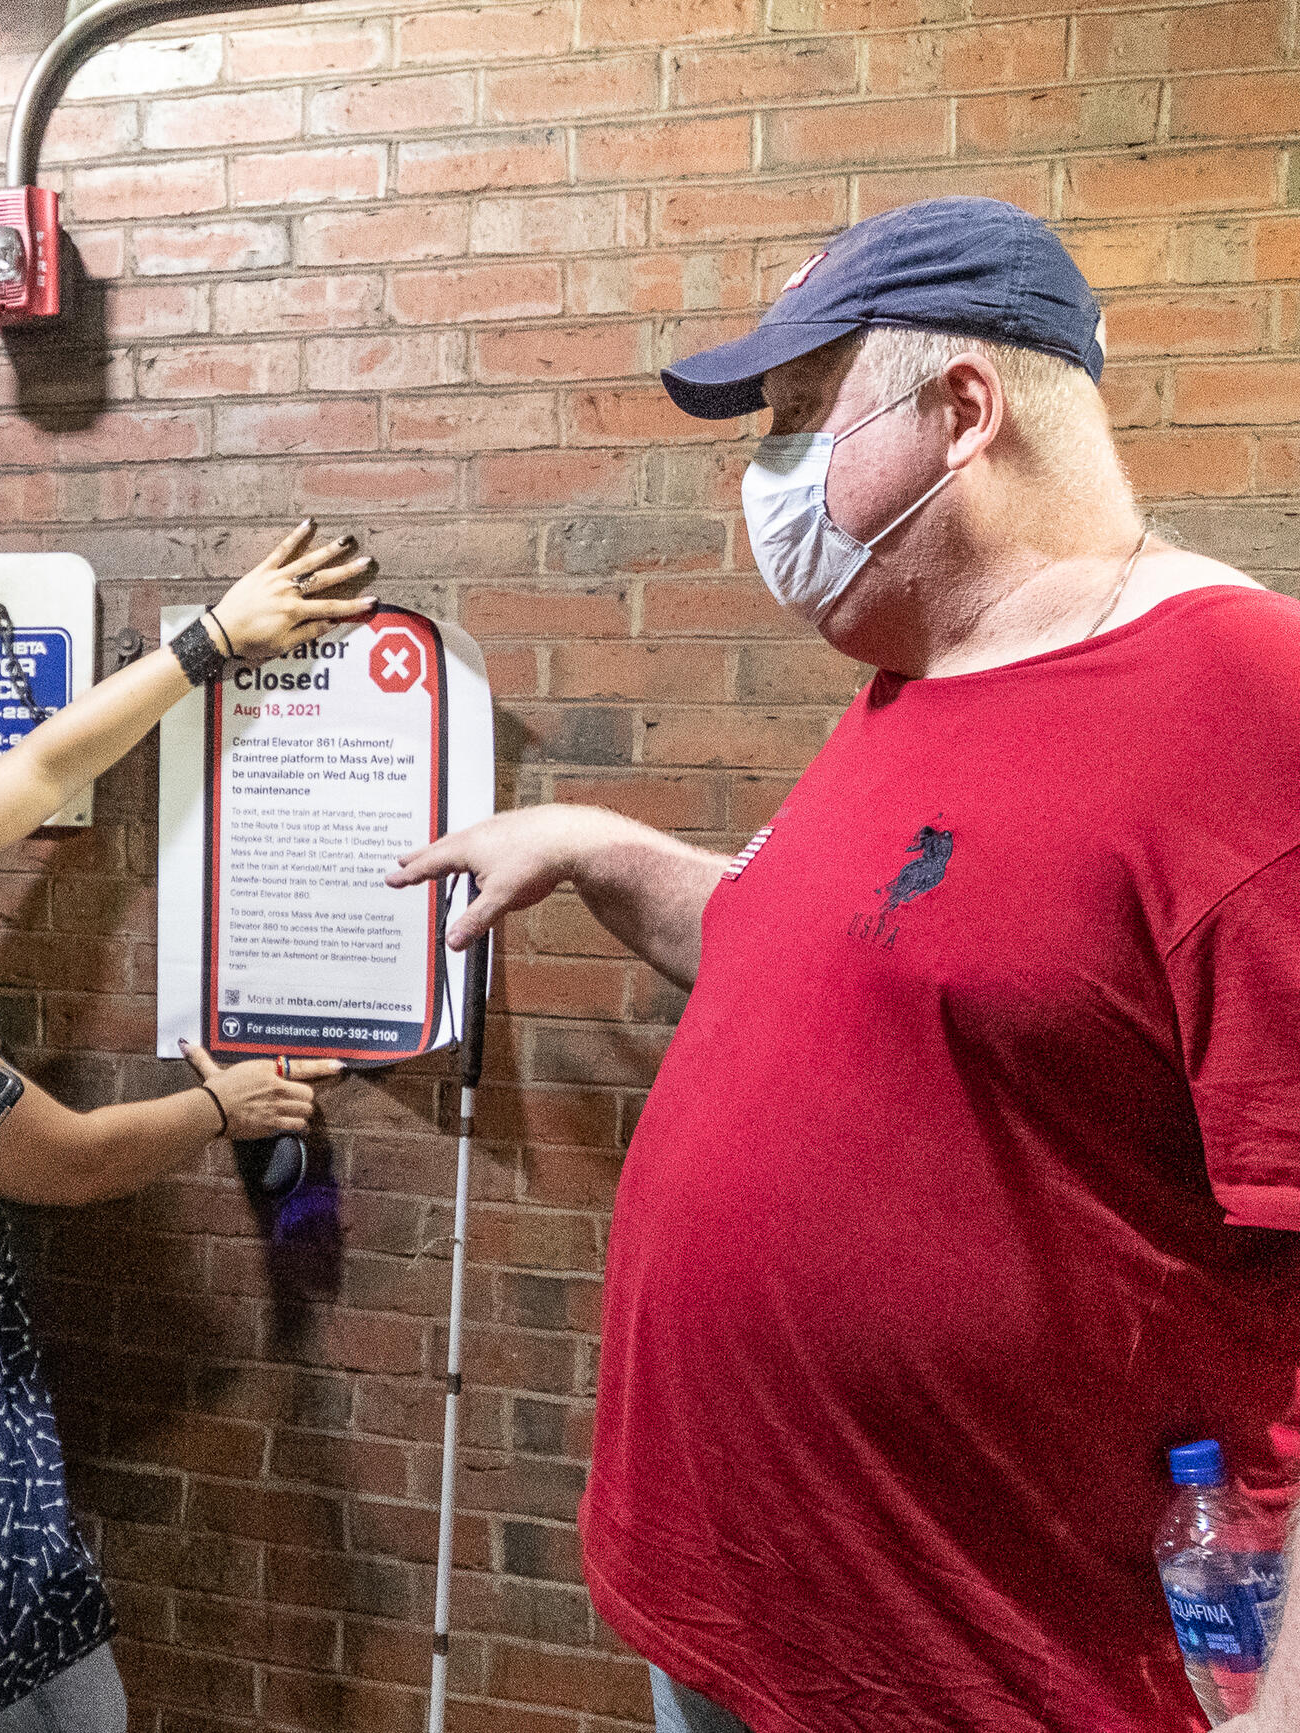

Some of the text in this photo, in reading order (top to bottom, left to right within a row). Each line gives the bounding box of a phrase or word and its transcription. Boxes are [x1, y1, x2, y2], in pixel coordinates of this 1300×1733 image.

[233, 667, 330, 691] Closed
[233, 704, 321, 718] Aug 18, 2021
[232, 737, 394, 749] Central Elevator 861 (Ashmont/
[232, 753, 414, 766] Braintree platform to Mass Ave) will
[232, 770, 407, 782] be unavailable on Wed Aug 18 due
[232, 786, 311, 796] to maintenance
[232, 807, 240, 815] To
[243, 808, 259, 816] exit,
[261, 808, 275, 816] exit
[278, 808, 290, 816] the
[292, 808, 310, 816] train
[322, 810, 356, 818] Harvard,
[359, 810, 376, 818] then
[379, 811, 412, 820] proceed
[256, 822, 278, 830] Route
[286, 822, 300, 830] bus
[303, 824, 320, 832] stop
[332, 824, 354, 832] Mass
[356, 824, 370, 832] Ave
[373, 824, 388, 832] and
[231, 835, 262, 844] Holyoke
[277, 836, 291, 844] and
[294, 836, 310, 844] take
[231, 848, 252, 856] Mass
[286, 850, 306, 858] Pearl
[308, 850, 316, 858] St
[246, 862, 260, 870] the
[340, 865, 354, 873] and
[357, 866, 374, 874] take
[231, 876, 287, 885] Alewife-bound
[290, 877, 307, 886] train
[310, 878, 317, 886] to
[319, 878, 350, 888] Central,
[230, 888, 258, 897] Central
[260, 890, 292, 898] Elevator
[230, 908, 240, 916] To
[241, 908, 266, 918] board,
[268, 910, 289, 918] cross
[292, 910, 312, 918] Mass
[315, 911, 330, 919] Ave
[332, 912, 346, 920] and
[365, 913, 394, 922] Central
[230, 922, 260, 930] Elevator
[280, 924, 288, 932] to
[336, 926, 364, 934] Alewife
[230, 935, 248, 943] Take
[262, 937, 318, 946] Alewife-bound
[321, 940, 339, 948] train
[341, 940, 349, 948] to
[351, 941, 383, 950] Harvard
[386, 942, 400, 950] and
[230, 948, 259, 957] transfer
[262, 950, 270, 958] to
[283, 952, 318, 960] Ashmont
[330, 954, 396, 964] Braintree-bound
[248, 994, 412, 1012] More at mbta.com/alerts/access
[247, 1024, 262, 1034] For
[265, 1025, 320, 1038] assistance:
